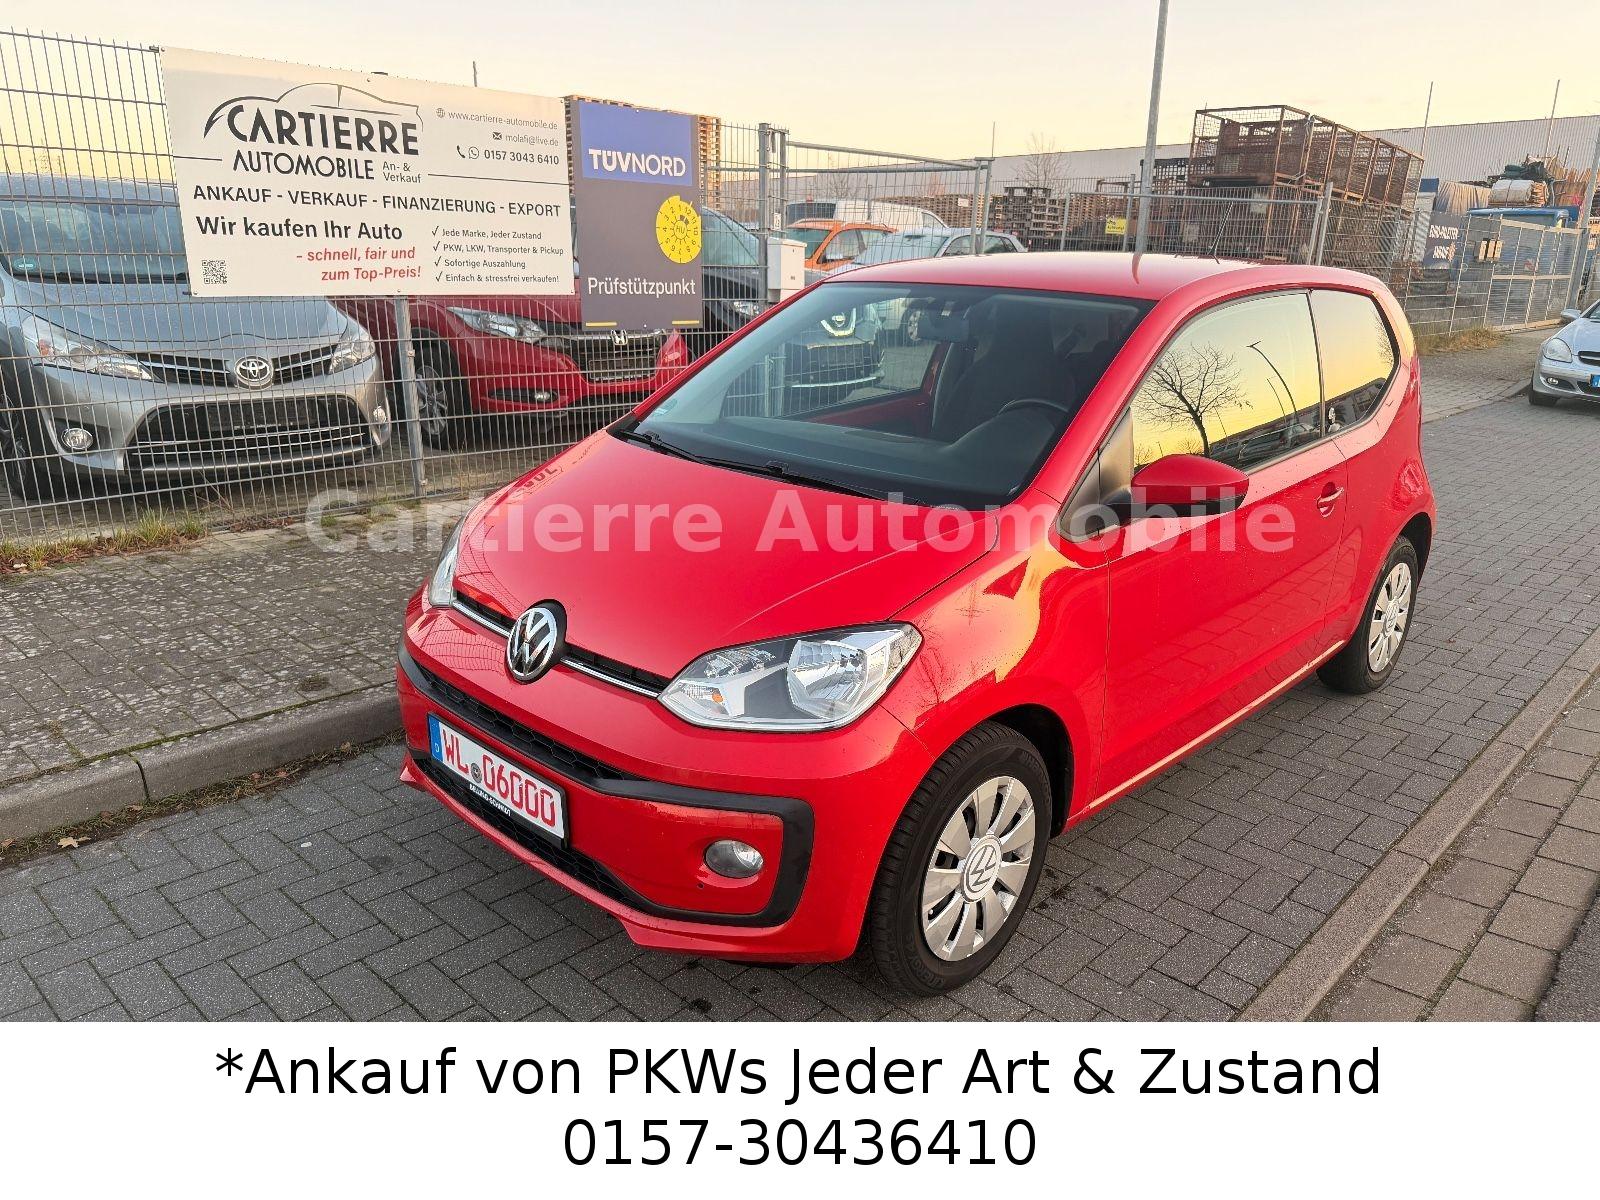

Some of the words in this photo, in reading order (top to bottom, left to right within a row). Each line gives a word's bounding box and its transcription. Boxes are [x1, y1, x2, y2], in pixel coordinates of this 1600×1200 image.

[448, 111, 558, 130] www.cartierre-automobile.de
[227, 105, 419, 156] CARTIERRE
[505, 134, 559, 147] molafi@live.de
[233, 149, 375, 181] AUTOMOBILE
[484, 149, 507, 160] 0157
[509, 151, 535, 163] 3043
[537, 154, 560, 165] 6410
[382, 161, 400, 172] An-
[403, 163, 411, 172] &
[382, 172, 422, 184] Verkauf
[193, 184, 272, 203] ANKAUF
[287, 189, 368, 208] VERKAUF
[383, 195, 496, 214] FINANZIERUNG
[508, 202, 561, 217] EXPORT
[196, 215, 237, 236] Wir
[243, 217, 317, 238] kaufen
[323, 220, 352, 239] Ihr
[357, 222, 403, 240] Auto
[442, 229, 460, 237] Jede
[462, 229, 489, 239] Marke,
[490, 230, 511, 239] Jeder
[512, 231, 542, 240] Zustand
[675, 225, 686, 235] HU
[307, 247, 362, 262] schnell,
[364, 246, 387, 260] fair
[391, 246, 416, 260] und
[443, 243, 464, 253] PKW,
[466, 244, 486, 253] LKW,
[487, 245, 531, 254] Transporter
[540, 246, 564, 256] Pickup
[444, 259, 480, 269] Sofortige
[482, 259, 526, 270] Auszahlung
[321, 270, 349, 281] zum
[353, 265, 422, 282] Top-Preis!
[445, 274, 475, 282] Einfach
[476, 274, 483, 282] &
[485, 274, 520, 283] stressfrei
[521, 274, 559, 283] verkaufen!
[587, 277, 697, 299] Prüfstützpunkt
[434, 742, 440, 753] D
[442, 728, 470, 775] WL
[482, 754, 556, 828] 06000
